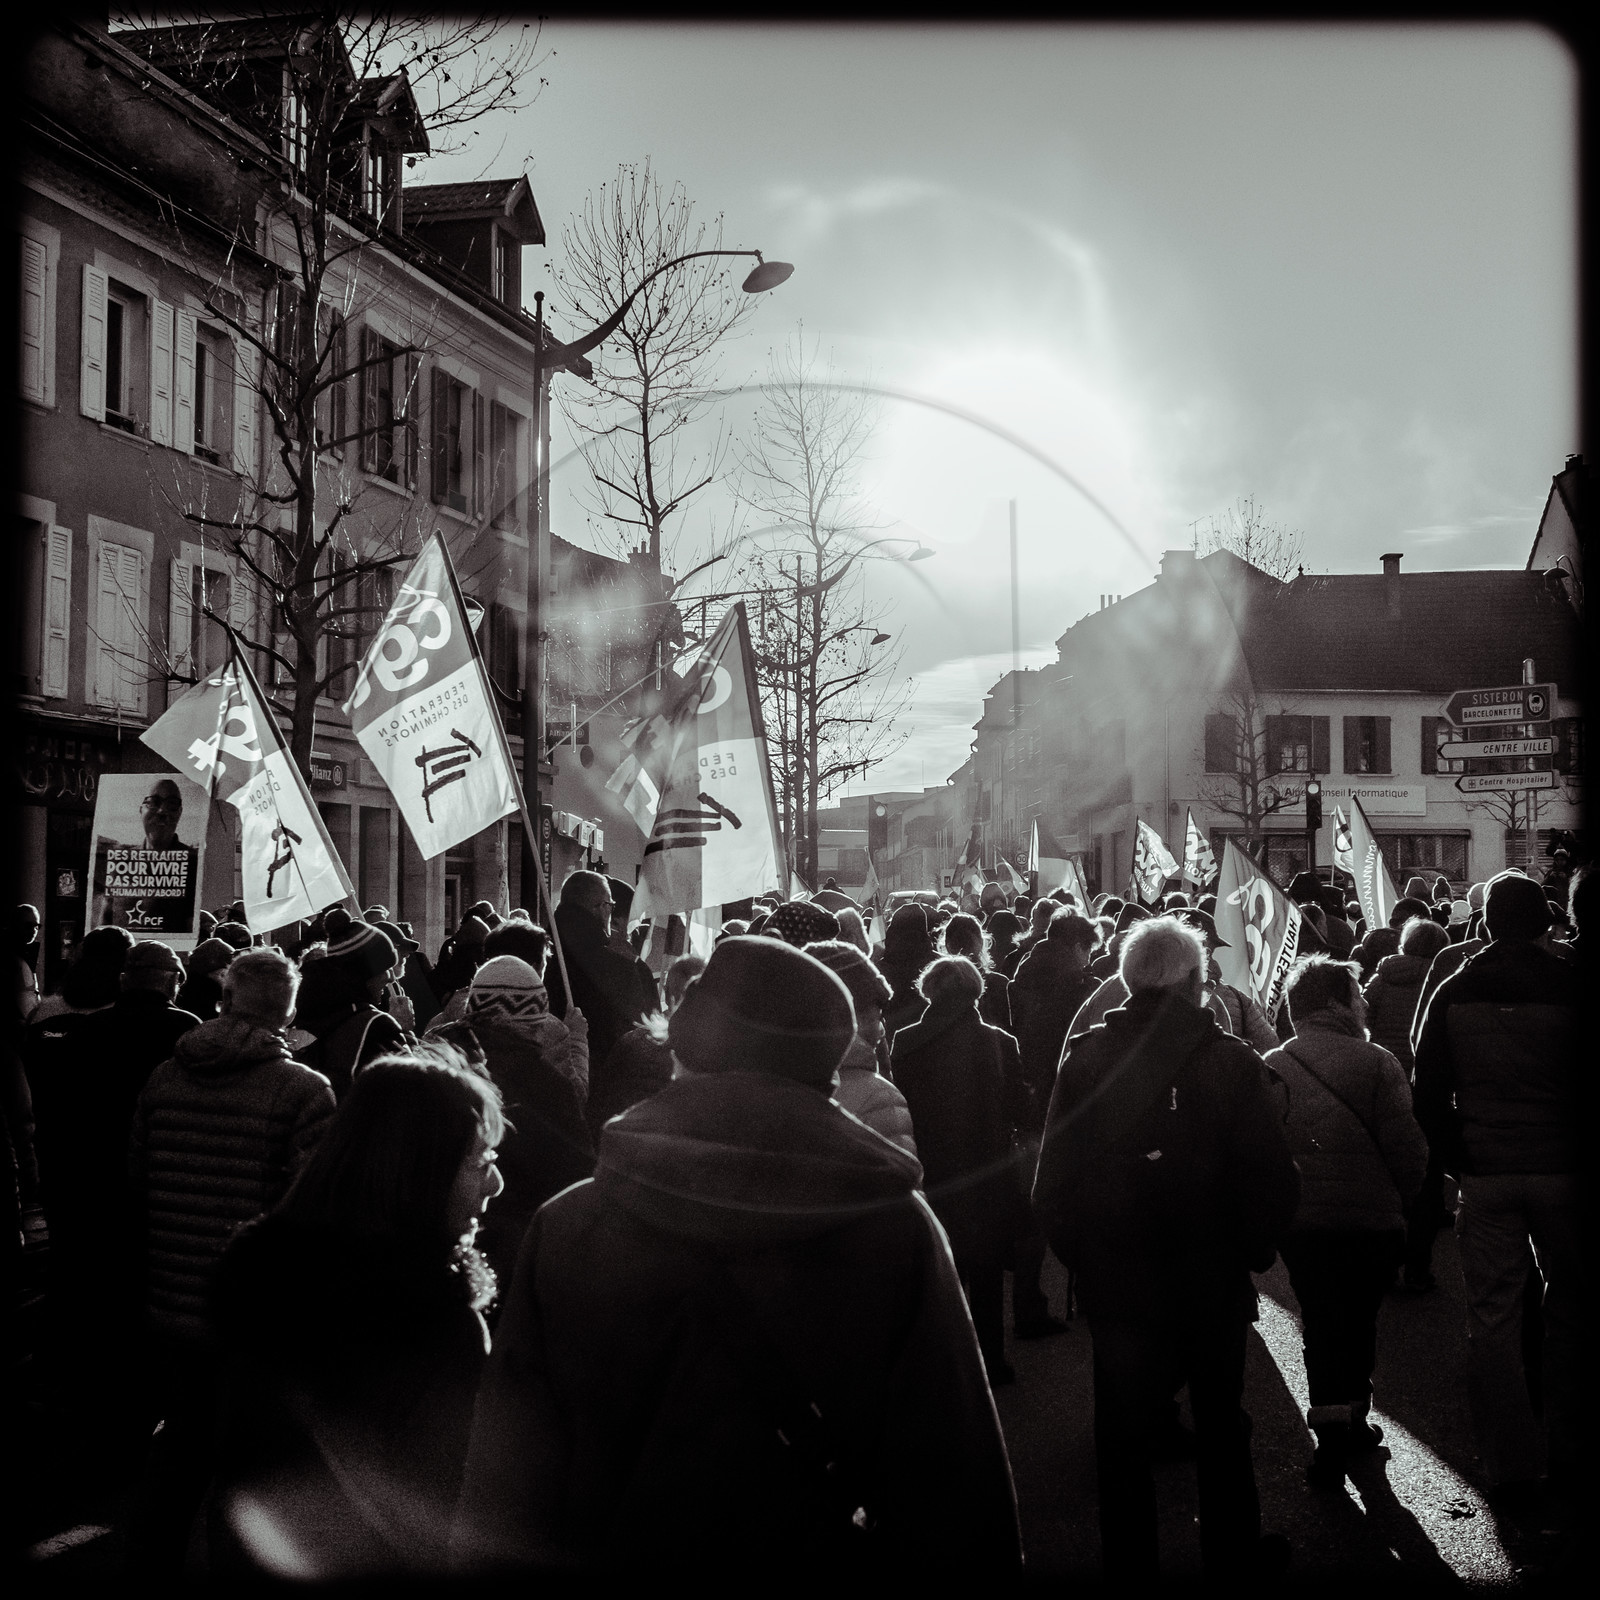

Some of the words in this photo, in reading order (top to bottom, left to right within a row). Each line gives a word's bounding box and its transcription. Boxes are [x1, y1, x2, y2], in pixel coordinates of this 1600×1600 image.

[1472, 691, 1523, 705] SISTERON
[1464, 708, 1521, 719] BARCELONNETTE
[1483, 744, 1518, 754] CENTRE
[1523, 742, 1548, 752] VILLE
[1479, 778, 1503, 786] Centre
[1506, 776, 1548, 786] Hospitalier
[1321, 788, 1346, 798] onseil
[1348, 788, 1409, 799] Informatique
[107, 850, 128, 861] DES
[131, 850, 188, 861] RETRAITES
[1018, 854, 1027, 863] 30
[106, 862, 147, 875] POUR
[150, 862, 188, 876] VIVRE
[105, 876, 129, 887] PAS
[132, 876, 187, 887] SURVIVRE
[105, 888, 145, 897] L'HUMAIN
[144, 916, 163, 926] PCF
